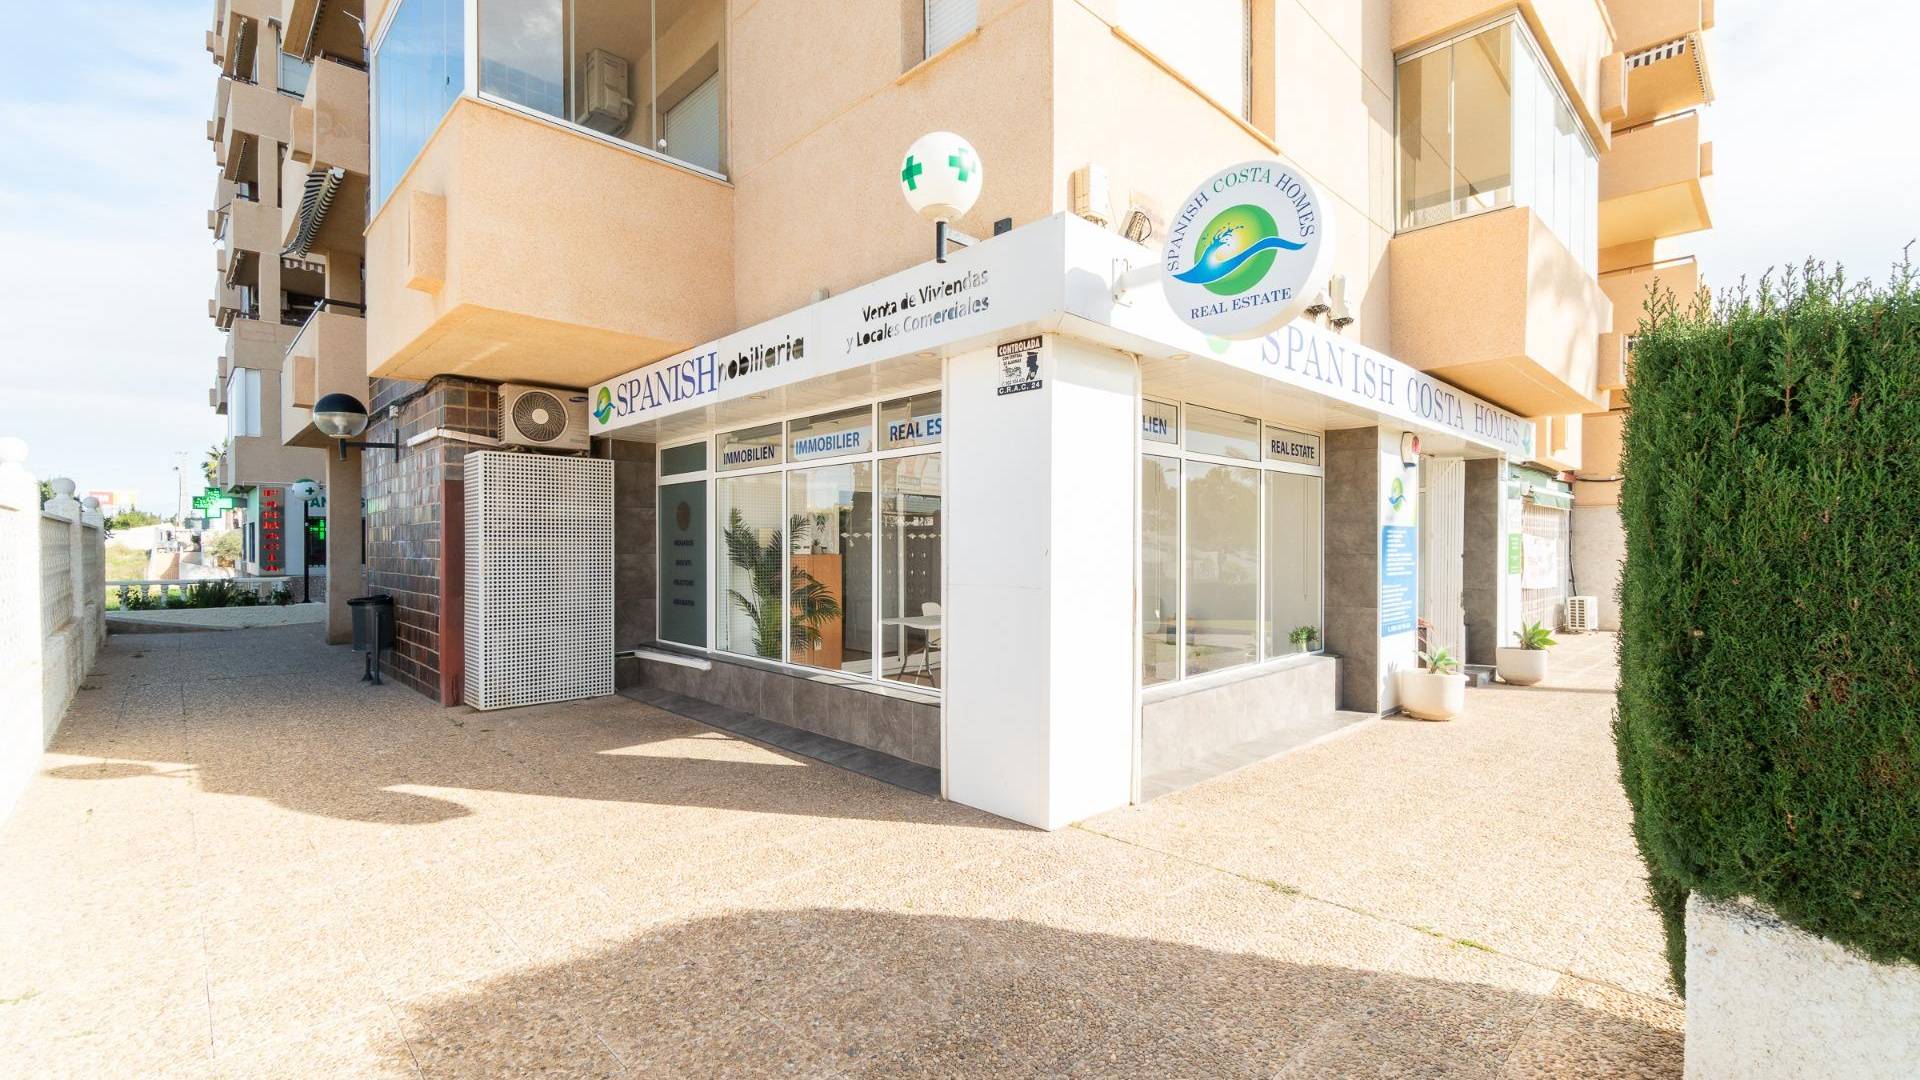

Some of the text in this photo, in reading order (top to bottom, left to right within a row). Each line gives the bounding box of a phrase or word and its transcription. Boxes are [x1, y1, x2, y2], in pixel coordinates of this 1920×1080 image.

[1167, 167, 1315, 272] SPANISH COSTA HOMES
[862, 270, 989, 322] Venta de Viviendas
[1191, 287, 1292, 320] REAL ESTATE
[846, 296, 989, 354] y Locales Comerciales
[999, 338, 1040, 356] CONTROLADA
[616, 351, 717, 417] SPANISH
[1261, 325, 1521, 446] SPANISH COSTA HOMES
[795, 431, 860, 455] IMMOBILIER
[890, 421, 923, 442] REAL
[723, 446, 775, 465] IMMOBILIEN
[1271, 439, 1315, 459] REAL ESTATE
